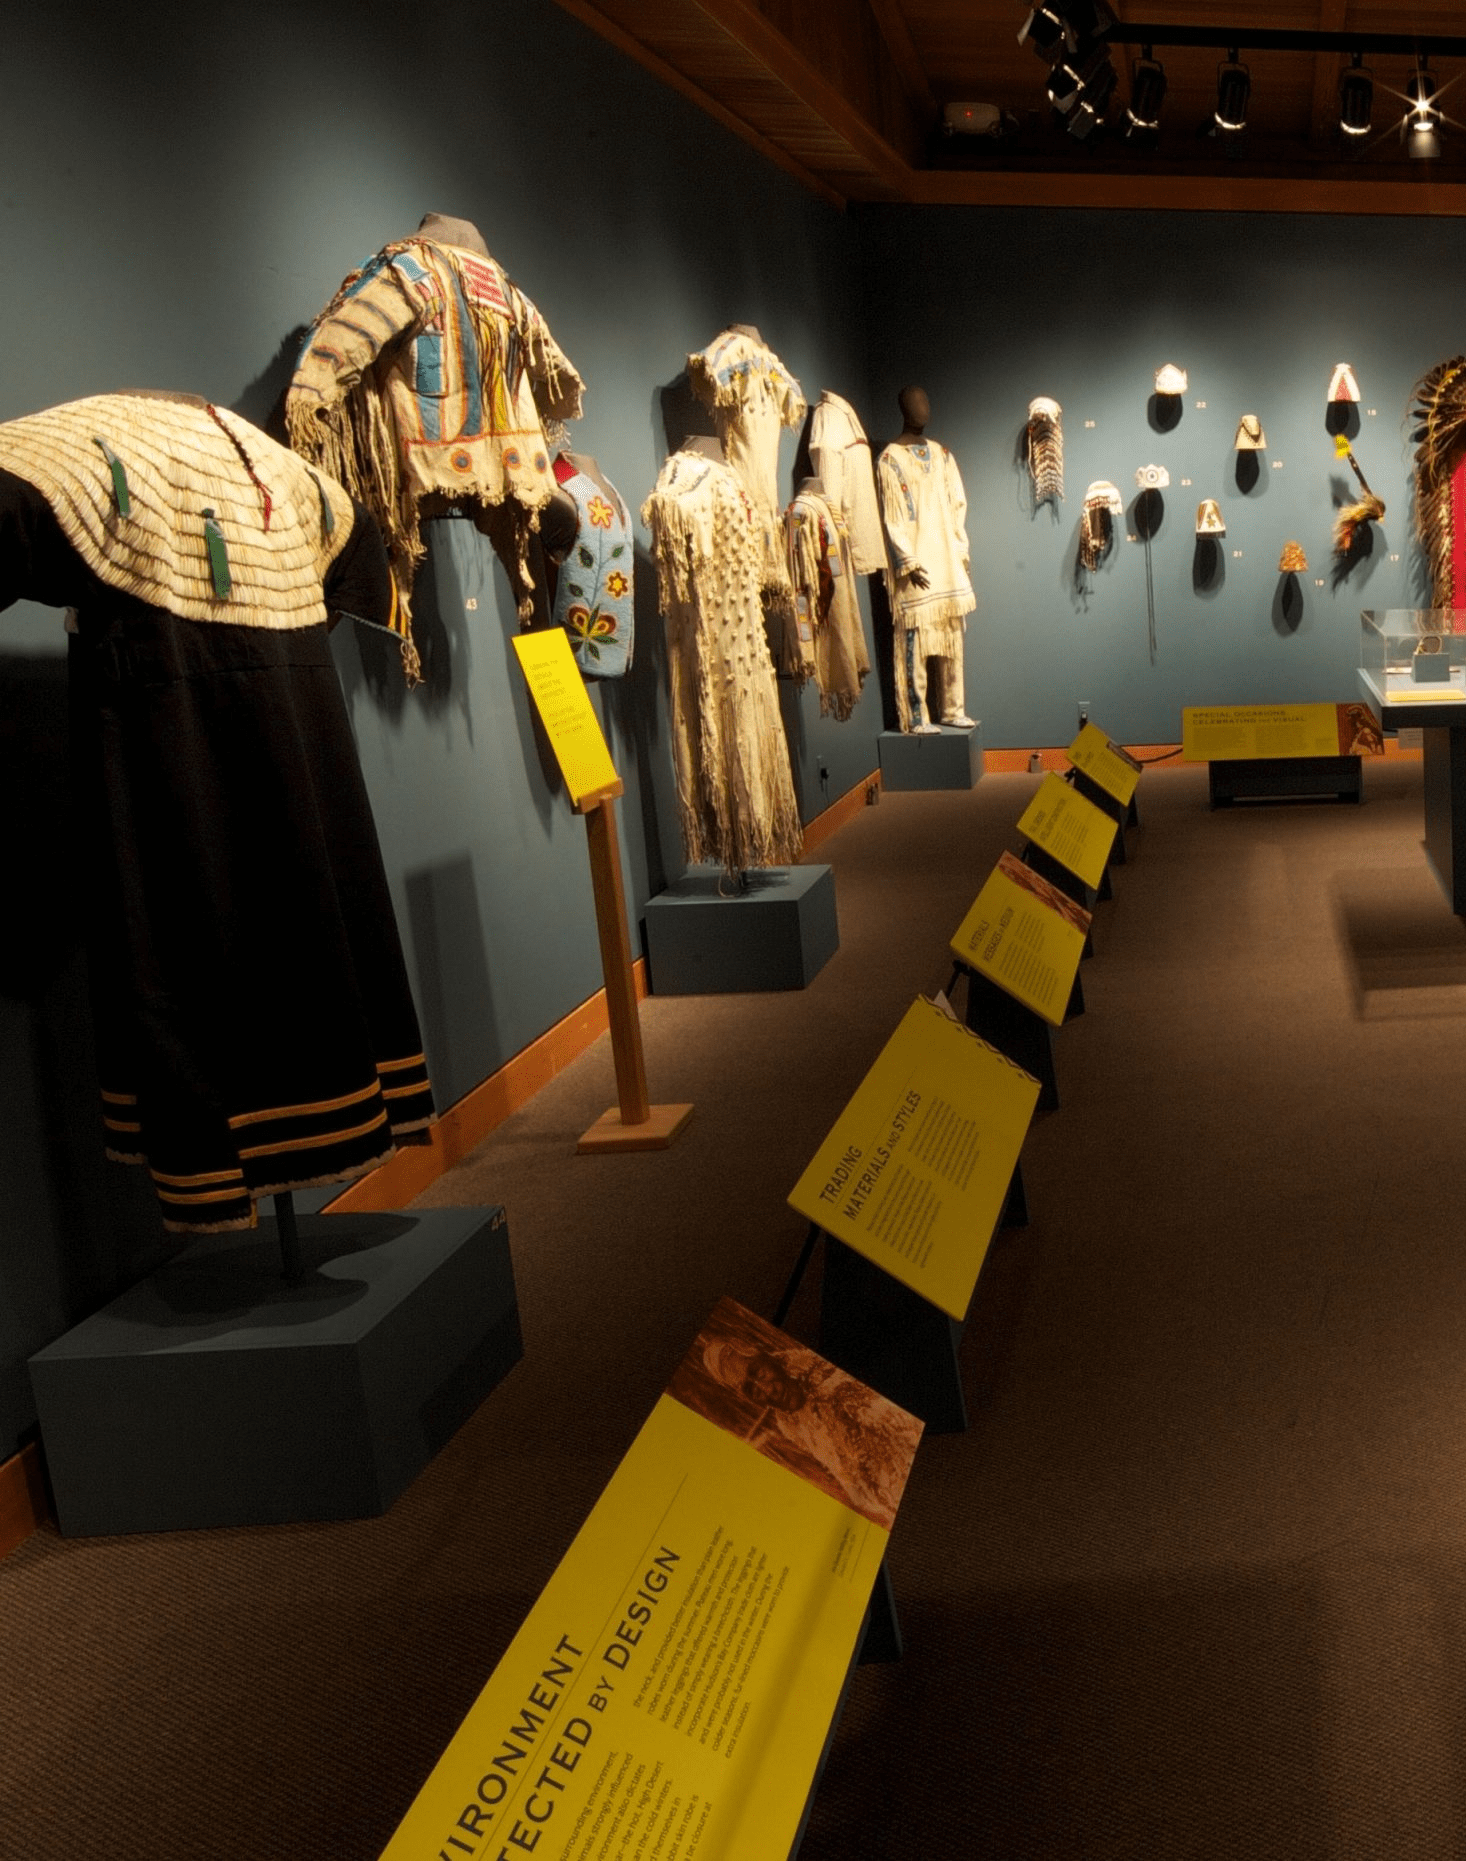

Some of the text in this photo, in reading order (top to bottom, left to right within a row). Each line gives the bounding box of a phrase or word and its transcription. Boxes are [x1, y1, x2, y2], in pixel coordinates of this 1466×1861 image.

[466, 598, 477, 609] 43
[819, 1145, 862, 1203] TRADING
[843, 1090, 921, 1220] MATERIALS AND STYLES
[587, 1675, 614, 1712] BY
[604, 1546, 681, 1670] DESIGN
[577, 1751, 633, 1861] imals strongly influenced
[617, 1797, 630, 1817] also
[625, 1763, 645, 1797] dictates
[636, 1789, 651, 1809] High
[645, 1760, 663, 1789] Desert
[637, 1832, 649, 1848] the
[645, 1810, 658, 1832] cold
[651, 1806, 677, 1855] themselves
[675, 1823, 687, 1842] skin
[682, 1802, 695, 1823] robe
[685, 1844, 696, 1856] tie
[691, 1811, 708, 1844] closure
